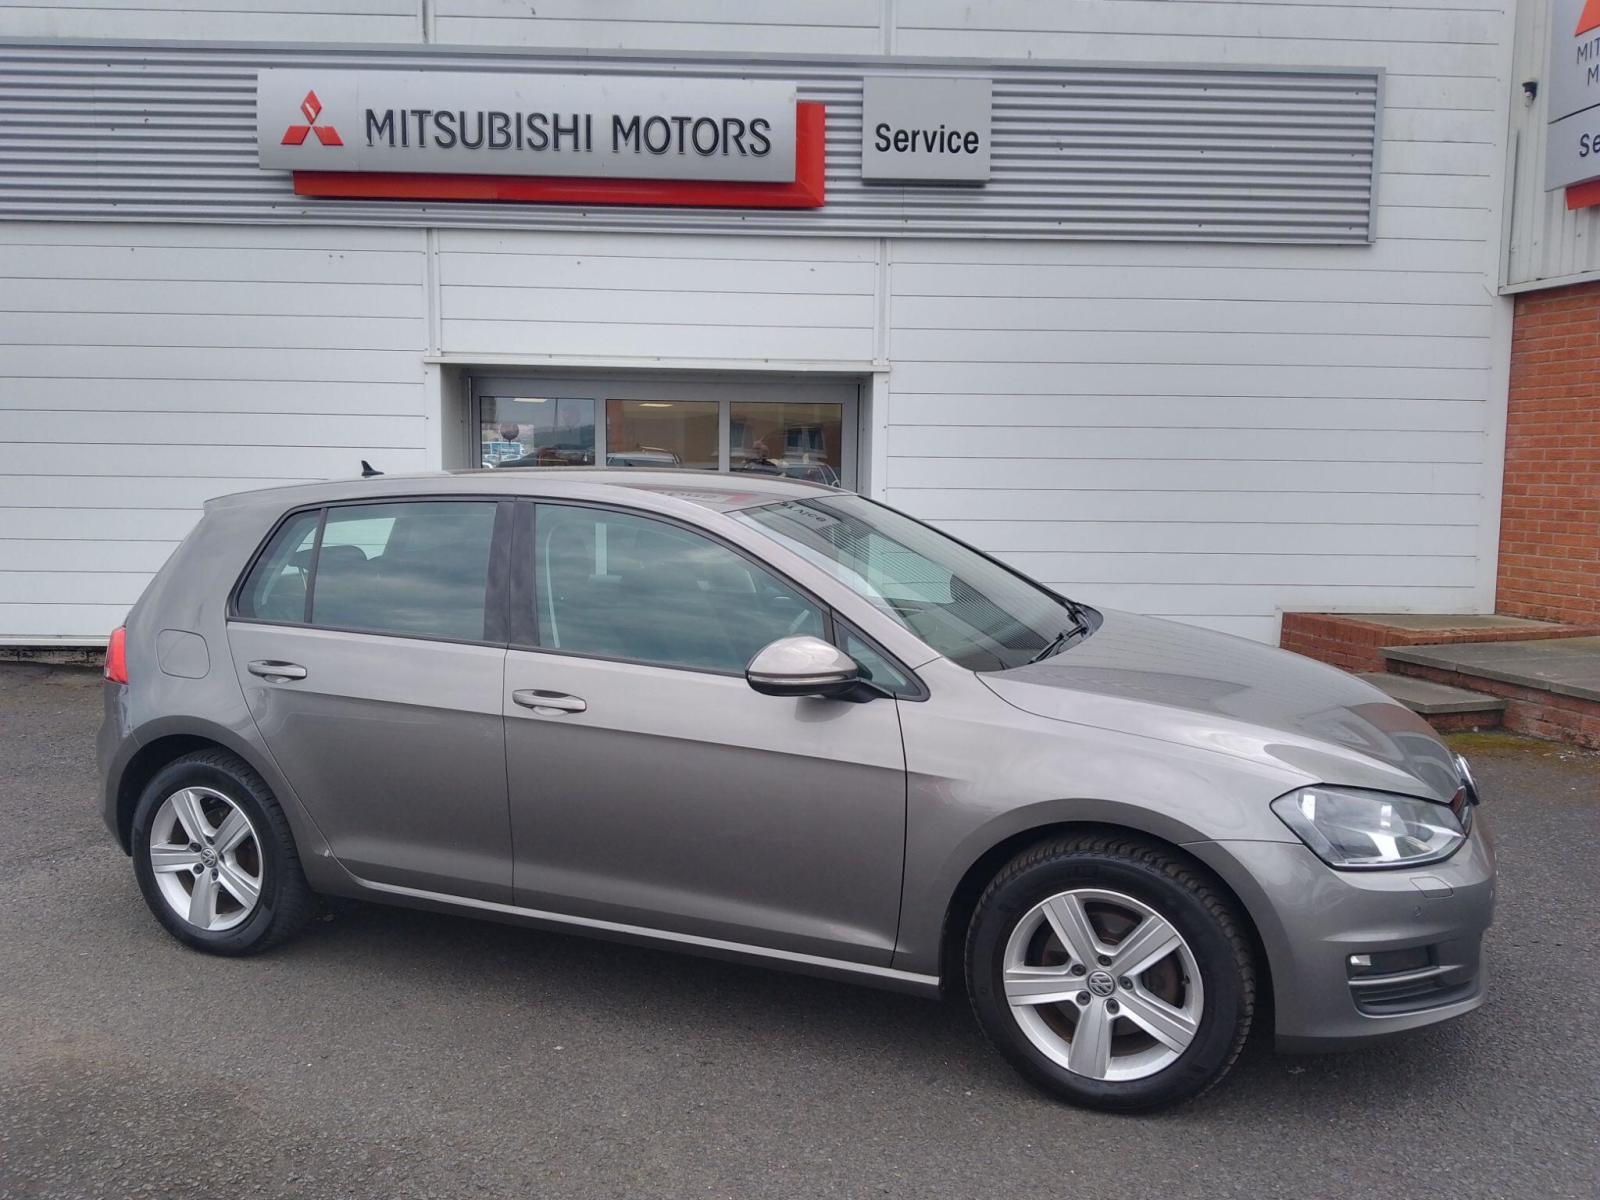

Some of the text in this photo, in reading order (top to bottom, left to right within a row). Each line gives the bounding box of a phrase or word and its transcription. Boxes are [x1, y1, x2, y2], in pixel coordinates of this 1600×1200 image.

[365, 108, 771, 156] MITSUBISHI MOTORS
[874, 122, 980, 154] Service
